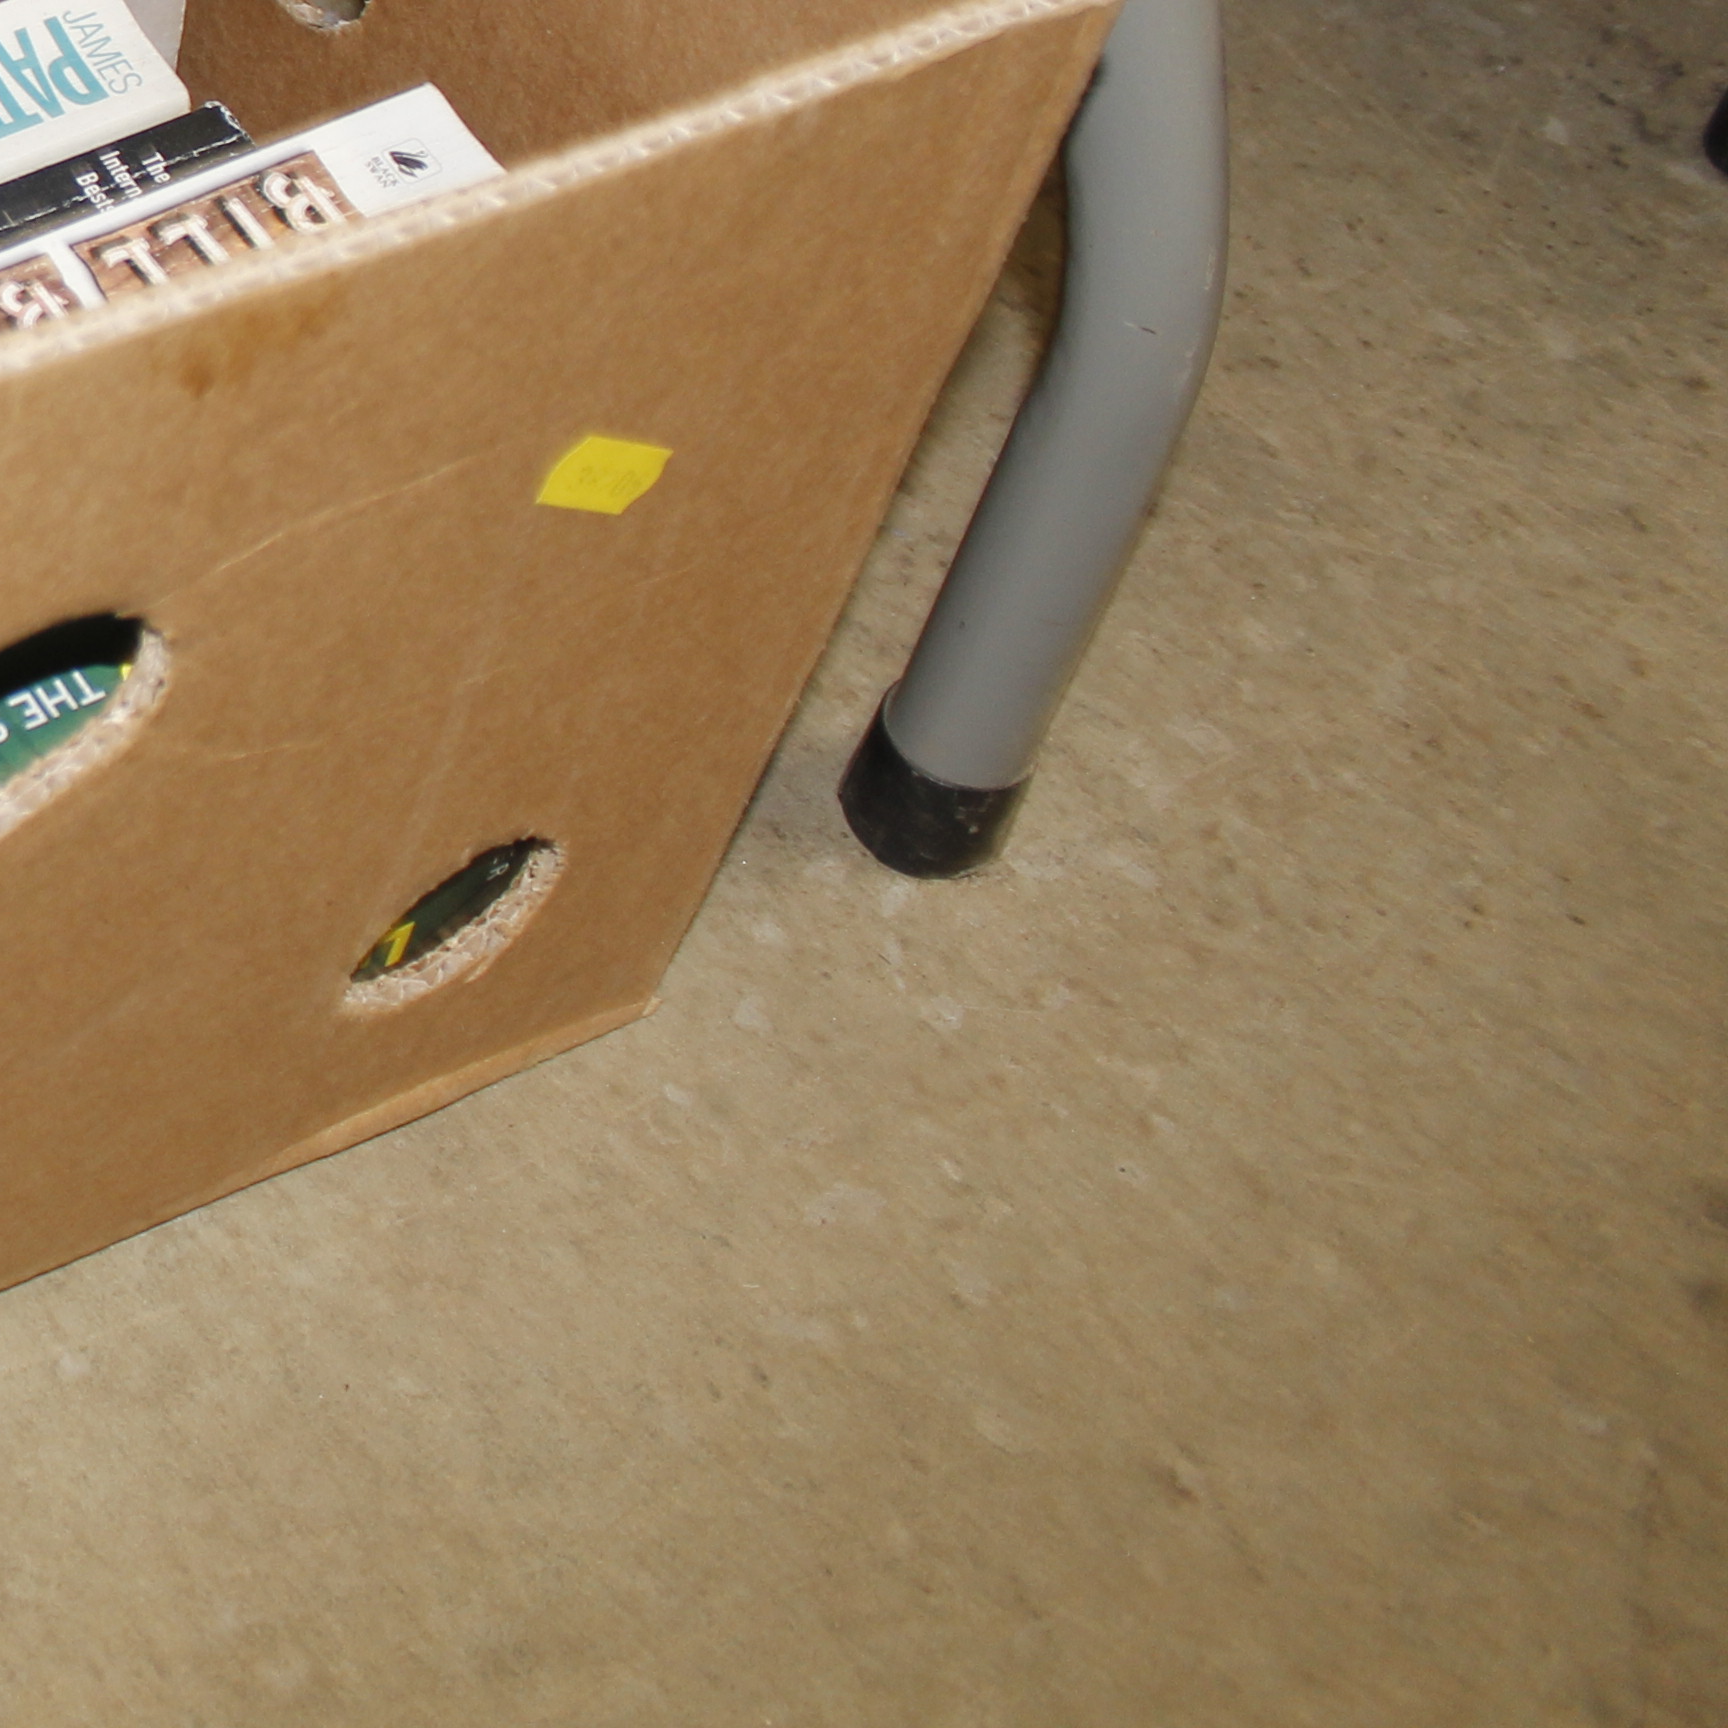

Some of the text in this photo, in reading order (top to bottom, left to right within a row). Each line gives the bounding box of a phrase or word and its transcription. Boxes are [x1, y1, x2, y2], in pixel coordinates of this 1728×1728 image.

[62, 9, 144, 95] JAMES
[141, 151, 171, 184] The
[98, 162, 349, 290] BILL
[7, 668, 108, 732] THE
